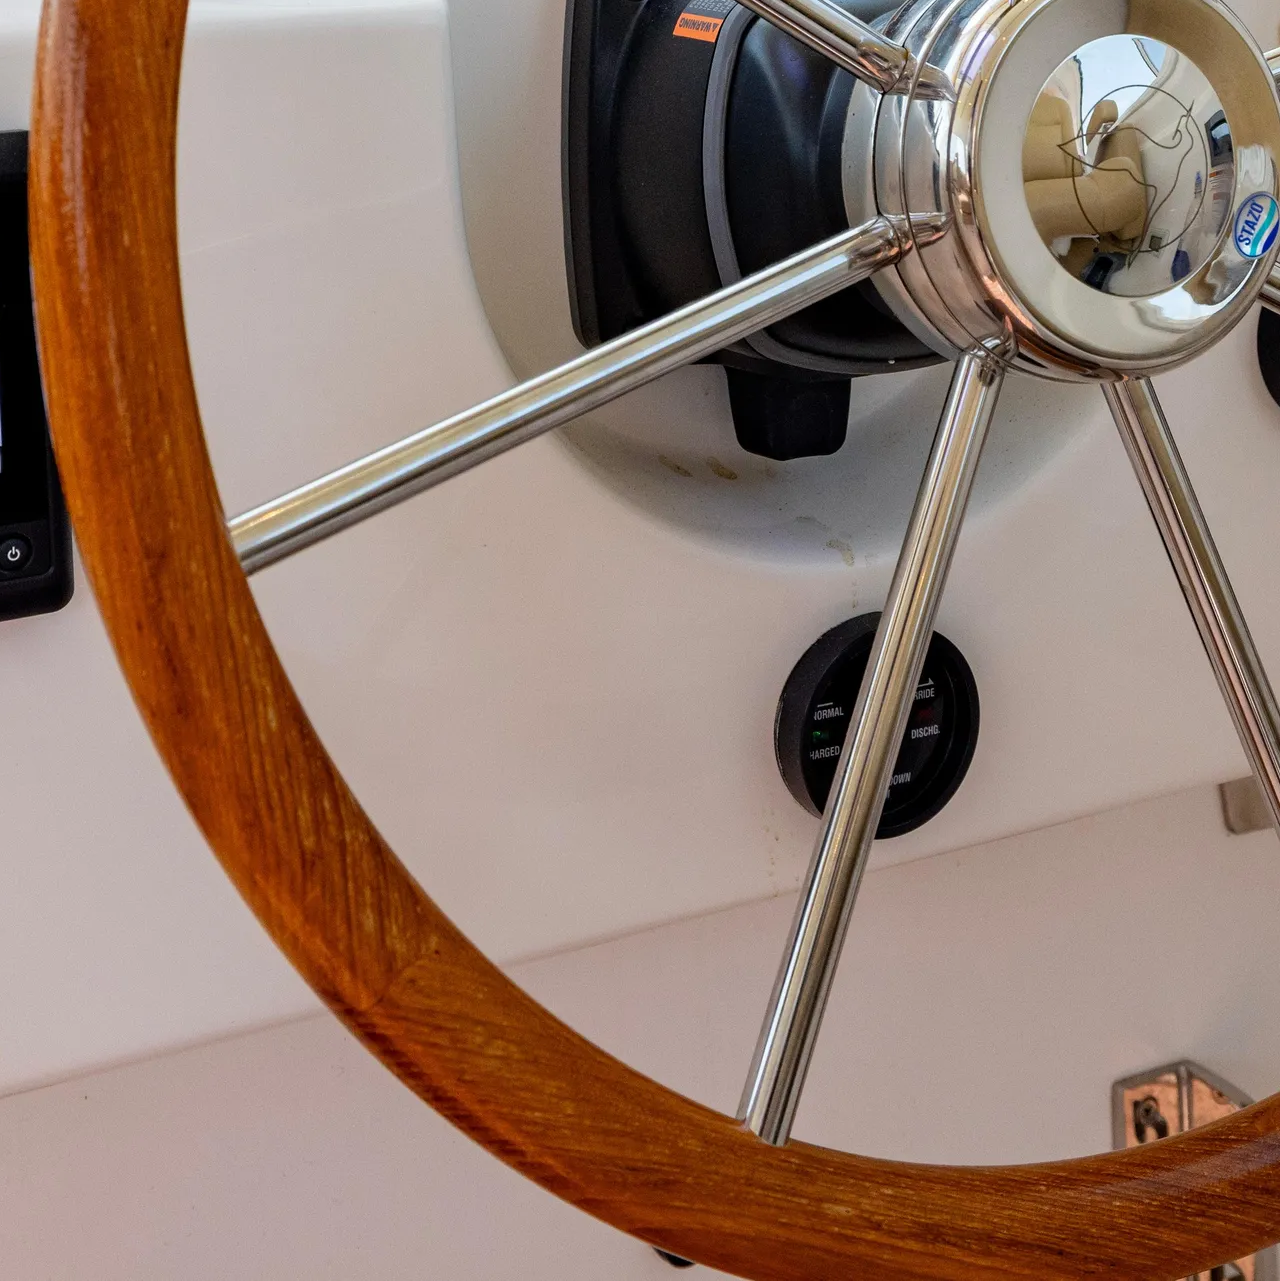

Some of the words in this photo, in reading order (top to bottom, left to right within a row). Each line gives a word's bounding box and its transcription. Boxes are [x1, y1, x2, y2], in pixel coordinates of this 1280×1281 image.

[678, 17, 712, 33] WARNING
[1238, 200, 1264, 246] STAZO
[810, 746, 840, 760] HARGED
